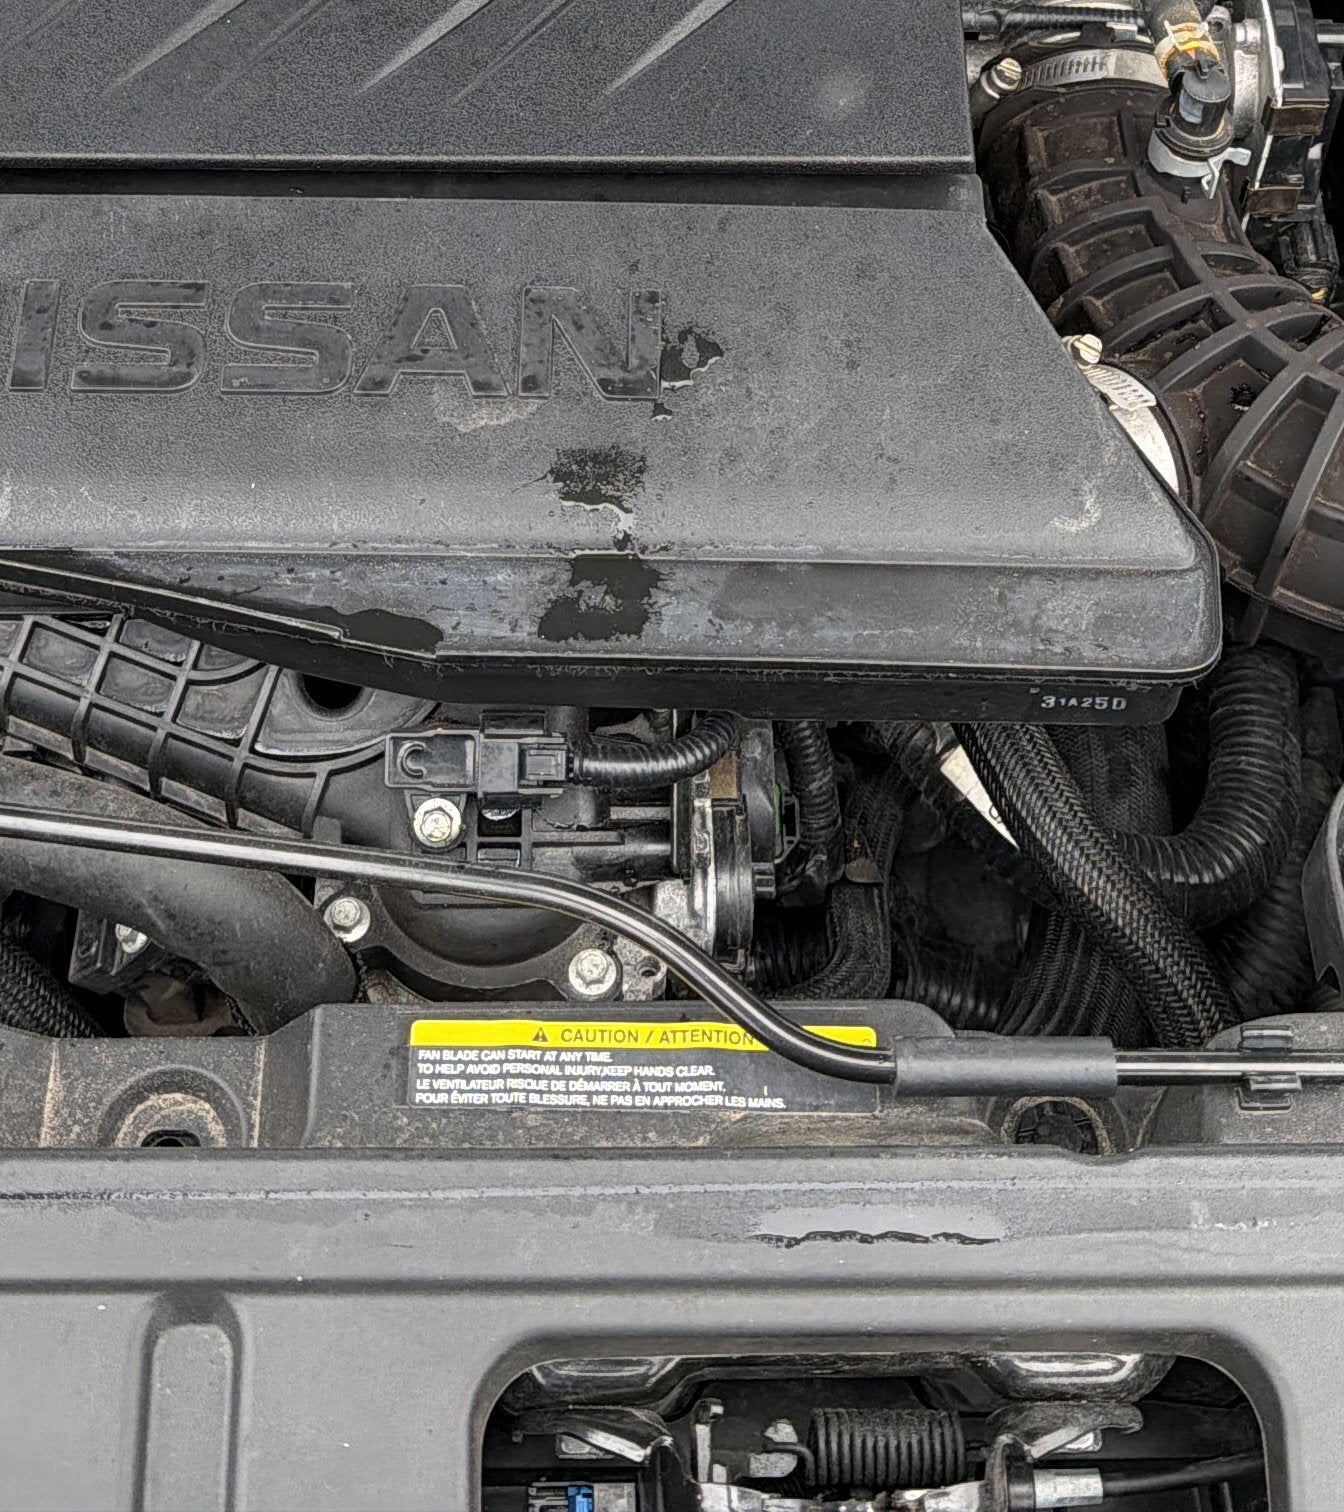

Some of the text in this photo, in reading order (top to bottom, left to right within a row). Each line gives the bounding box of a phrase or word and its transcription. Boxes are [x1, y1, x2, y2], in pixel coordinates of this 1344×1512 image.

[560, 1027, 756, 1046] CAUTION / ATTENTION
[418, 1049, 440, 1060] FAN
[442, 1049, 479, 1061] BLADE
[481, 1049, 504, 1061] CAN
[506, 1049, 541, 1061] START
[543, 1050, 559, 1061] AT
[560, 1051, 583, 1061] ANY
[417, 1062, 434, 1074] TO
[435, 1063, 464, 1075] HELP
[466, 1063, 500, 1075] AVOID
[502, 1063, 561, 1075] PERSONAL
[634, 1065, 673, 1076] HANDS
[675, 1065, 715, 1076] CLEAR.
[416, 1077, 726, 1093] LE VENTILATEUR RISQUE DE DÉMARRER À TOUT MOMENT.
[415, 1091, 786, 1109] POUR ÉVITER TOUTE BLESSURE, NE PAS EN APPROCHER LES MAINS.
